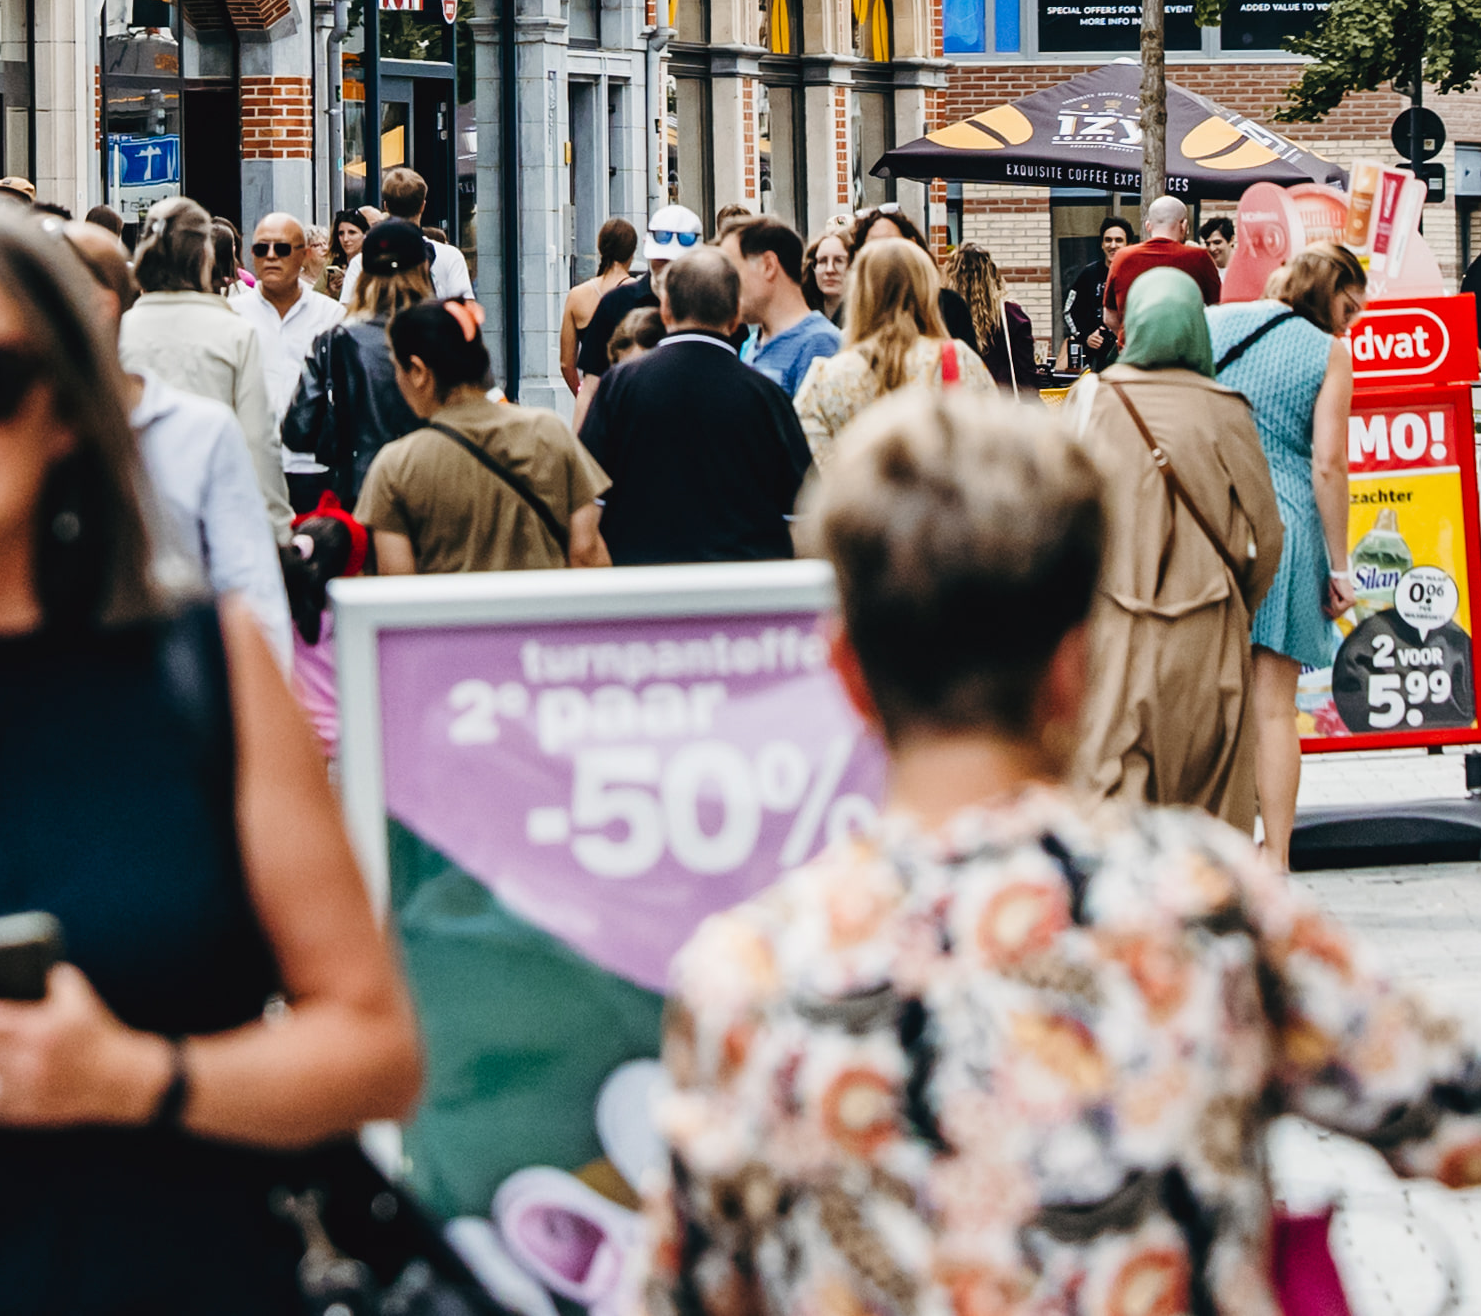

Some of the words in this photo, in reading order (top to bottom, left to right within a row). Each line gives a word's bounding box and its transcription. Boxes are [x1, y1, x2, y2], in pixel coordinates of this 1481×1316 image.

[1047, 6, 1080, 15] SPECIAL
[1084, 6, 1117, 15] OFFERS
[1119, 6, 1137, 15] FOR
[1108, 17, 1130, 26] INFO
[1006, 163, 1063, 180] EXQUISITE
[1068, 168, 1108, 184] COFFEE
[1348, 411, 1448, 463] MO!
[1371, 634, 1396, 668] 2
[1397, 647, 1445, 667] VOOR
[535, 681, 728, 756] paar
[1368, 669, 1453, 729] 5.99
[526, 733, 883, 878] -50%
